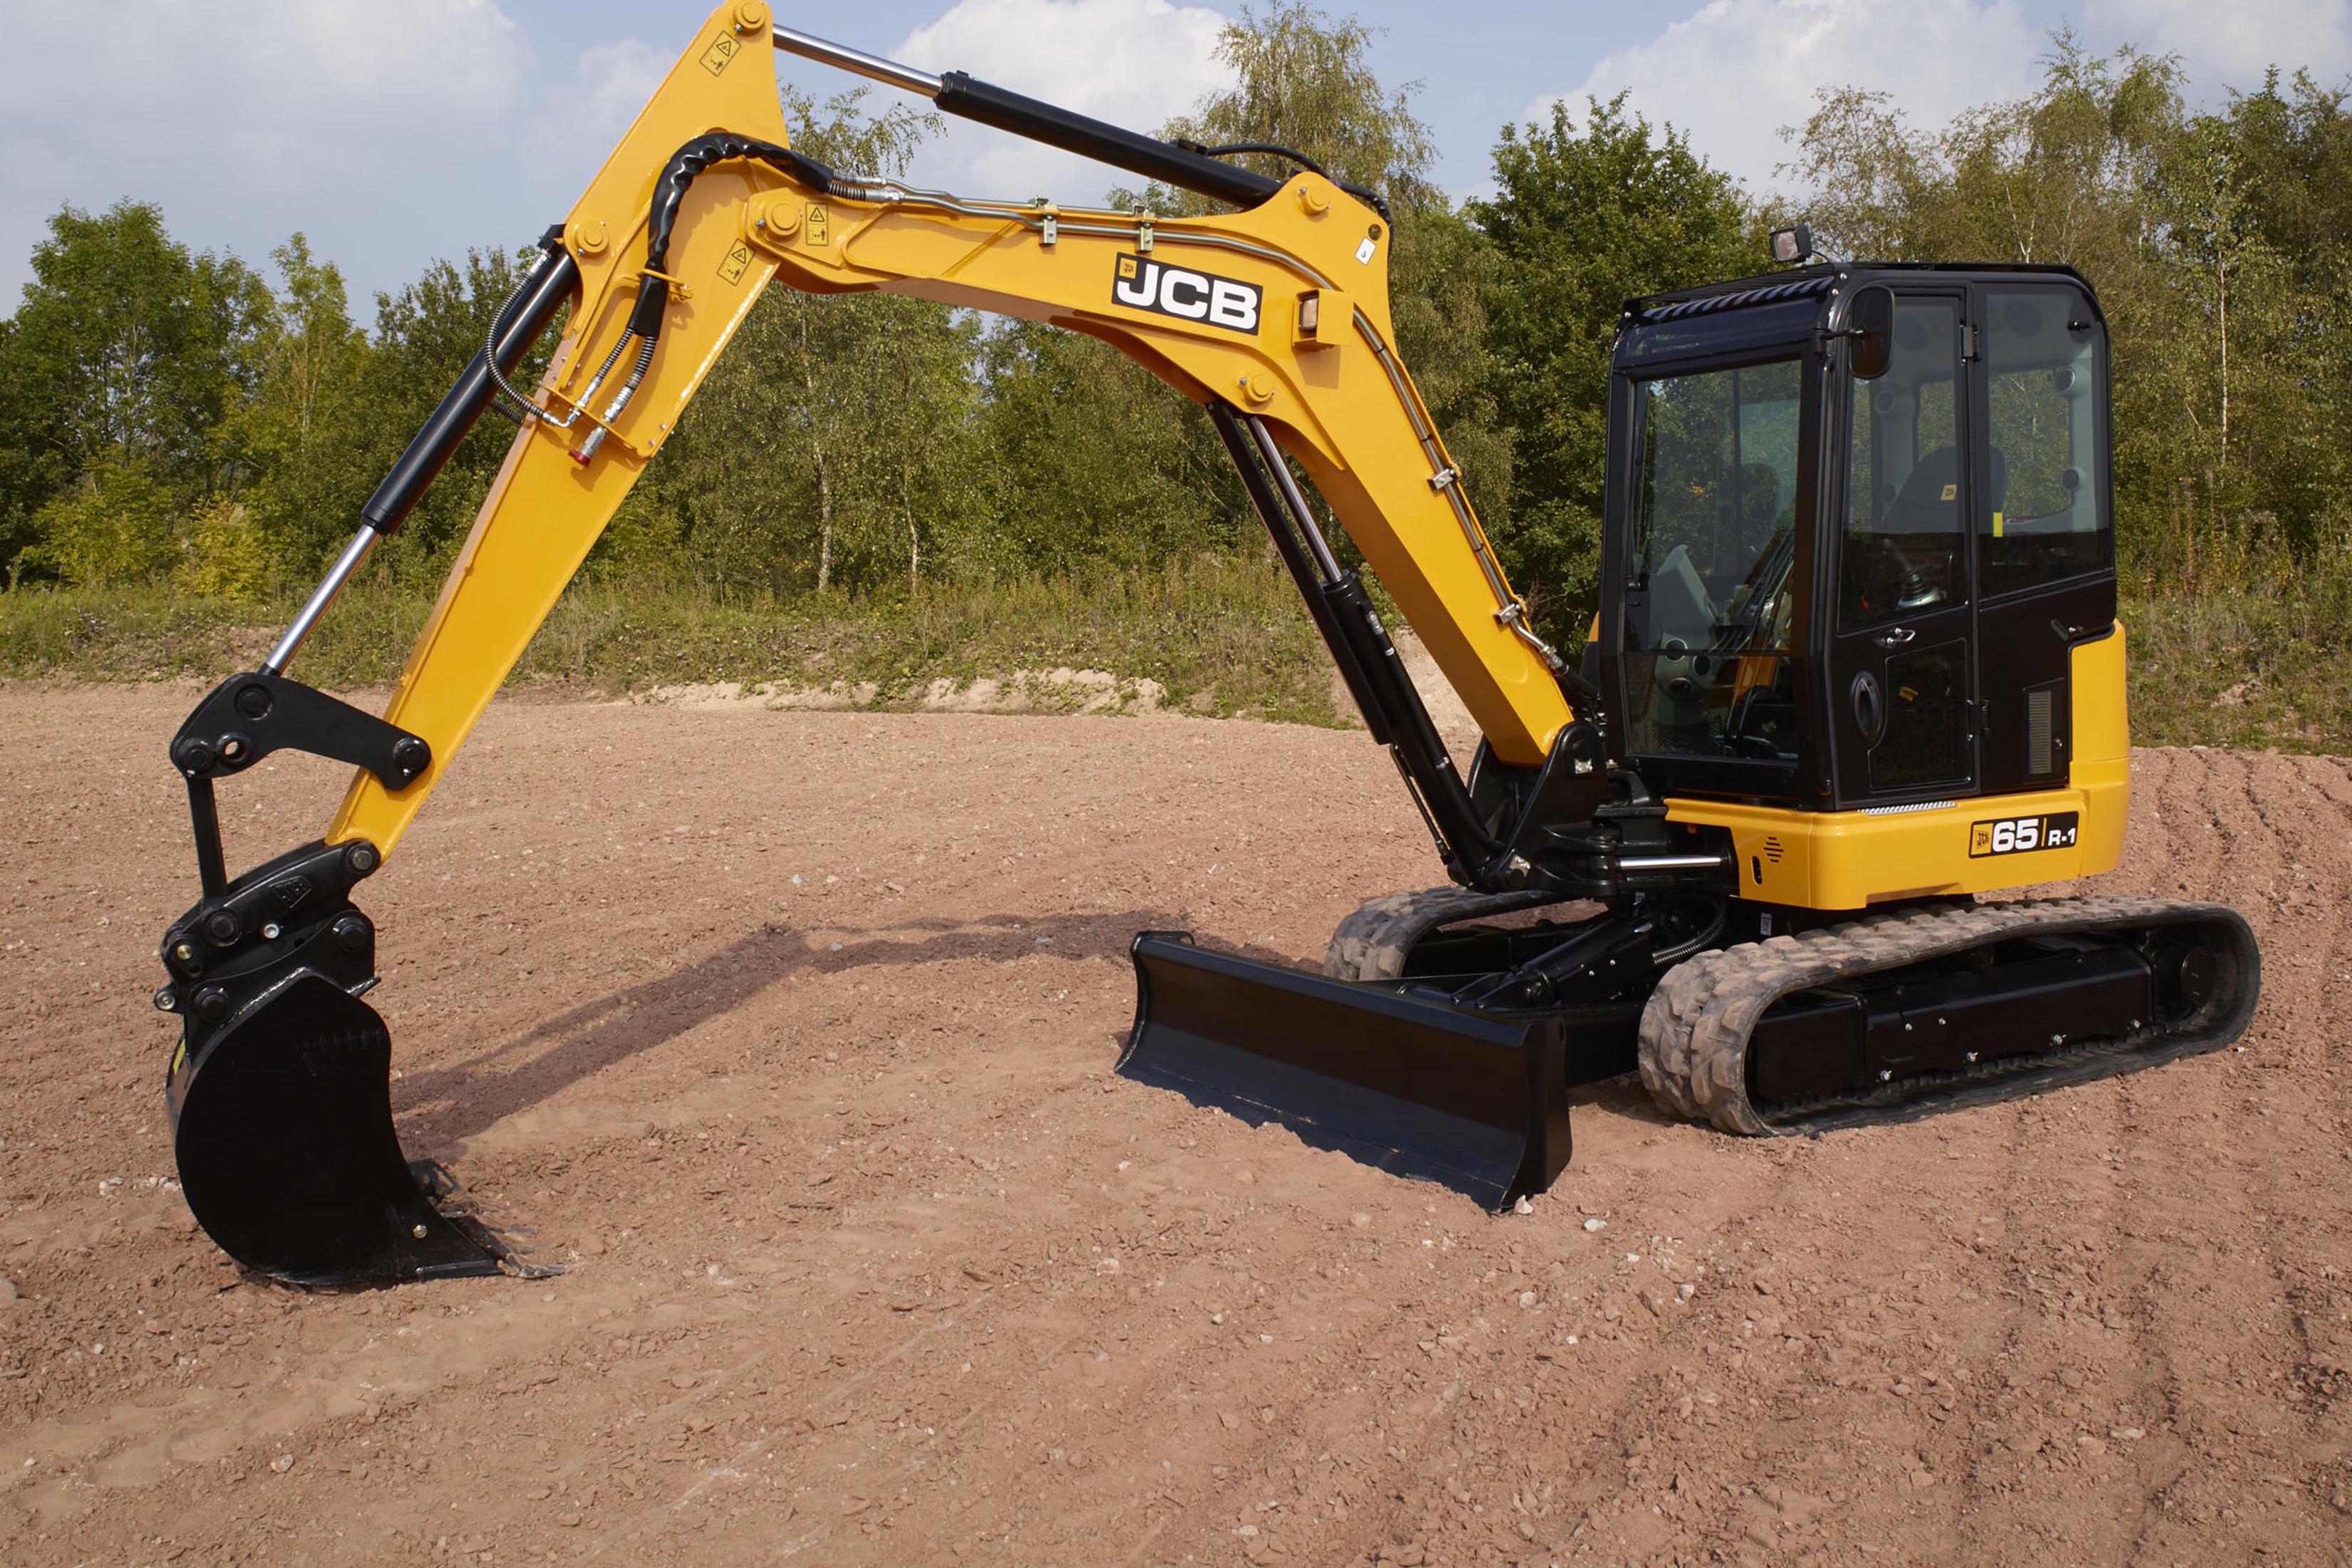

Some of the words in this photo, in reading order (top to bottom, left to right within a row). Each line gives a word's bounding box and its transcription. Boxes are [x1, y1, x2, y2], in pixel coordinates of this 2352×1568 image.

[1117, 263, 1257, 329] JCB
[1977, 832, 1989, 846] JCB
[1992, 819, 2039, 852] 65
[2048, 827, 2076, 846] R-1
